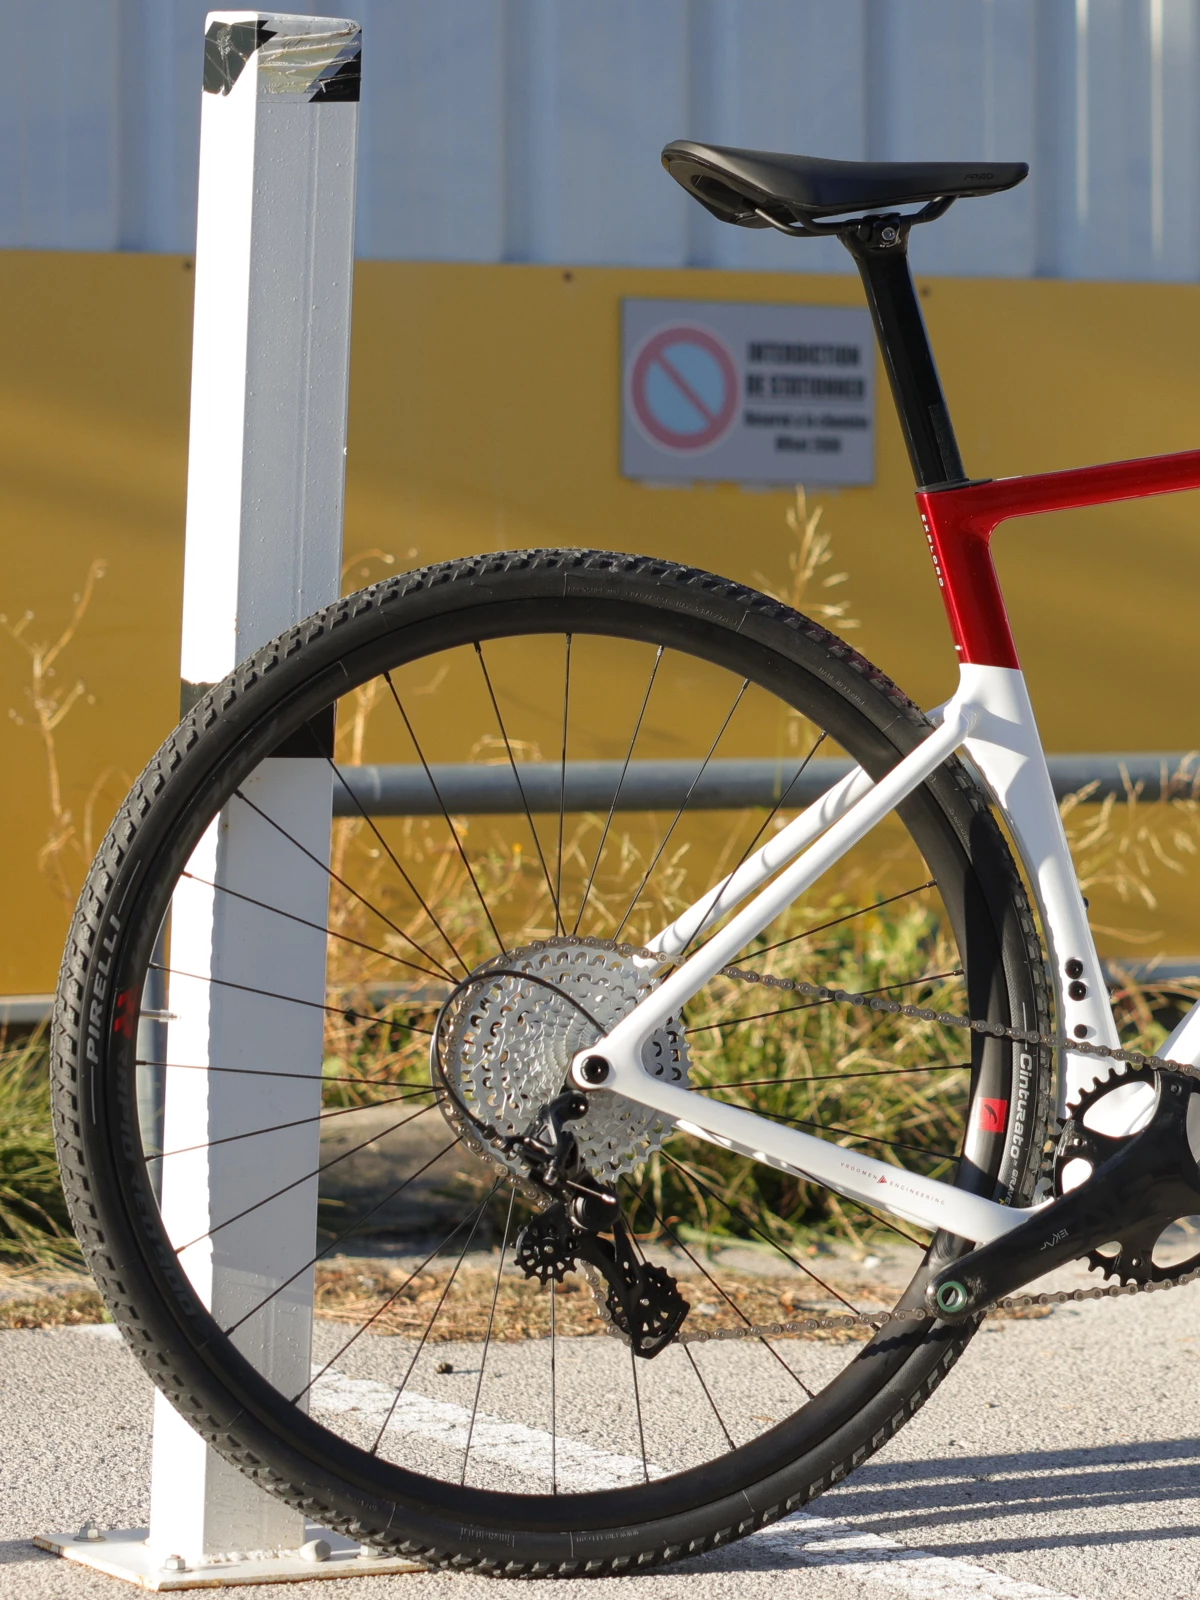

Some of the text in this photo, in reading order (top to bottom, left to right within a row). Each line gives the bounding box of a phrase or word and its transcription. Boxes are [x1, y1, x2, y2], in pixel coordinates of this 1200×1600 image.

[86, 914, 121, 1066] PIRELLI
[840, 1161, 946, 1205] VROOMEN ENGINEERING
[1004, 1052, 1033, 1206] Cinturato GRAVE
